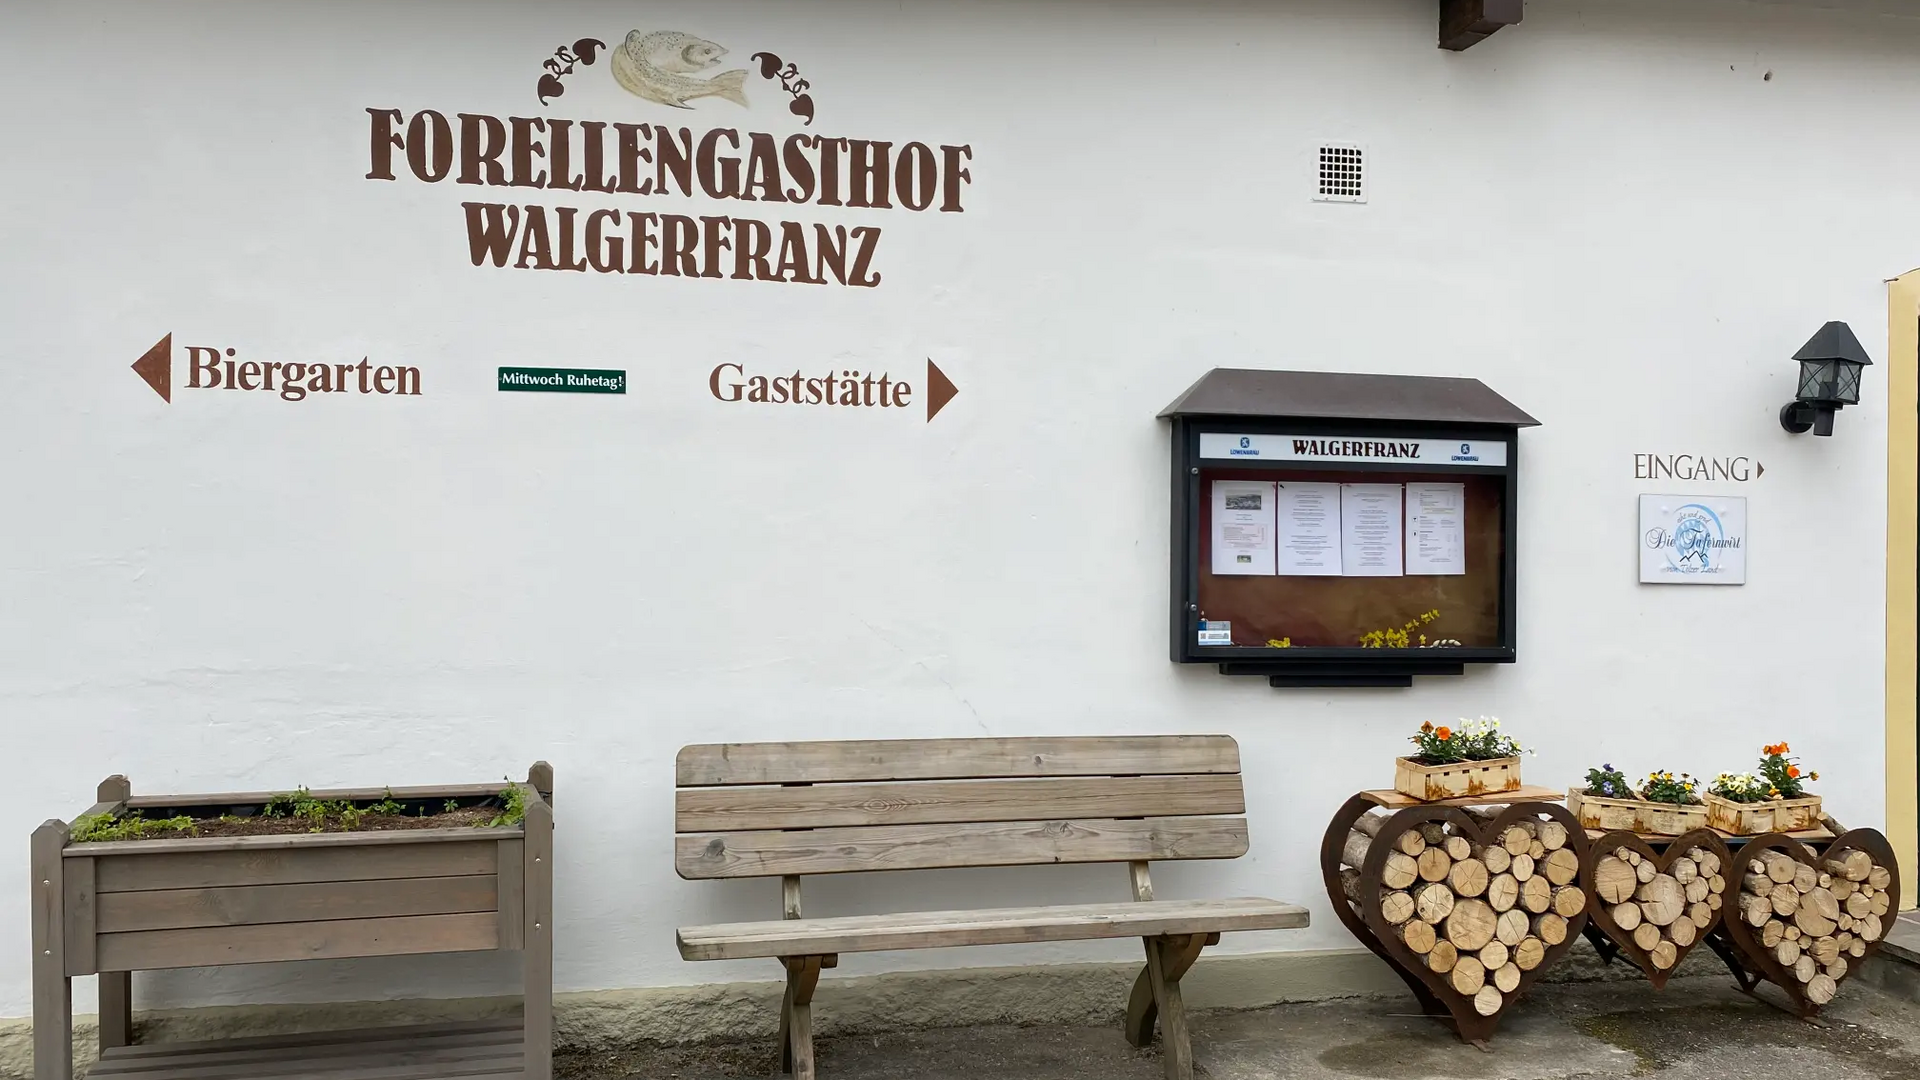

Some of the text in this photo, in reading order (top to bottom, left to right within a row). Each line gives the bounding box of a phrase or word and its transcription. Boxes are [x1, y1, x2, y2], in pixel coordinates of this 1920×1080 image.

[365, 107, 973, 213] FORELLENGASTHOF
[460, 201, 882, 288] WALGERFRANZ
[184, 346, 423, 402] Biergarten
[502, 372, 623, 390] Mittwoch Ruhetag!
[709, 363, 912, 408] Gaststätte
[1292, 439, 1421, 459] WALGERFRANZ
[1634, 453, 1750, 482] EINGANG
[1645, 527, 1675, 549] Die
